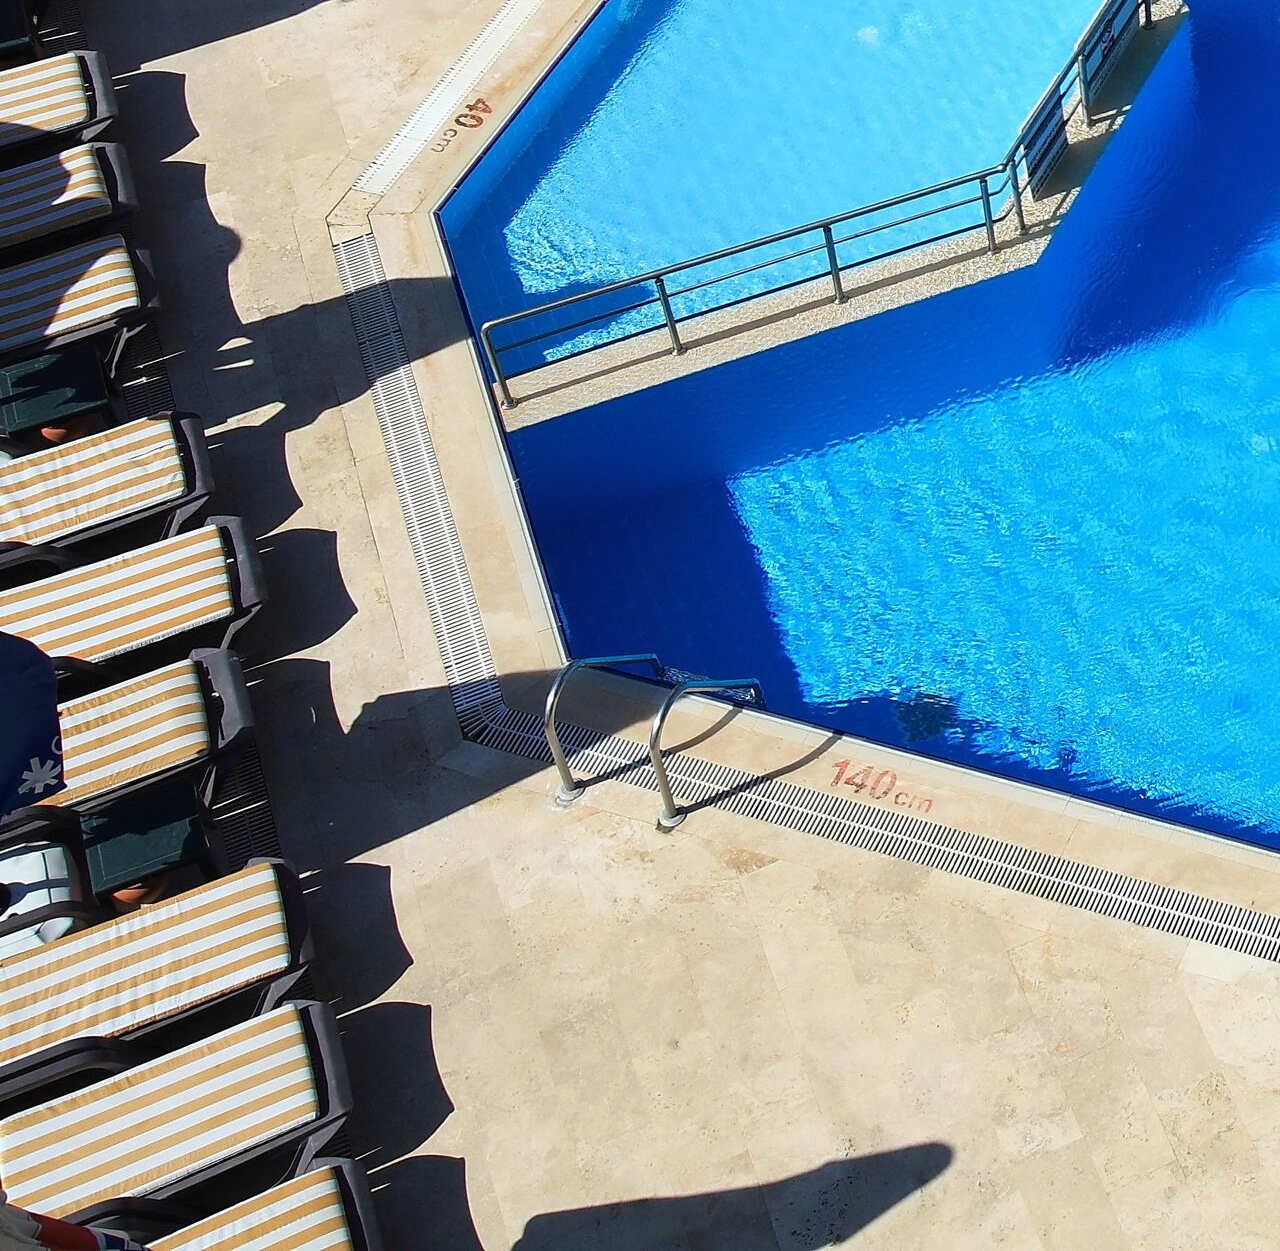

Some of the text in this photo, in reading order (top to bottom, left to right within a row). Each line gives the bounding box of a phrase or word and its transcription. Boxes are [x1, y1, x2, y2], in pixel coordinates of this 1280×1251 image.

[431, 98, 493, 153] 40 cm
[831, 759, 934, 813] 140 cm
